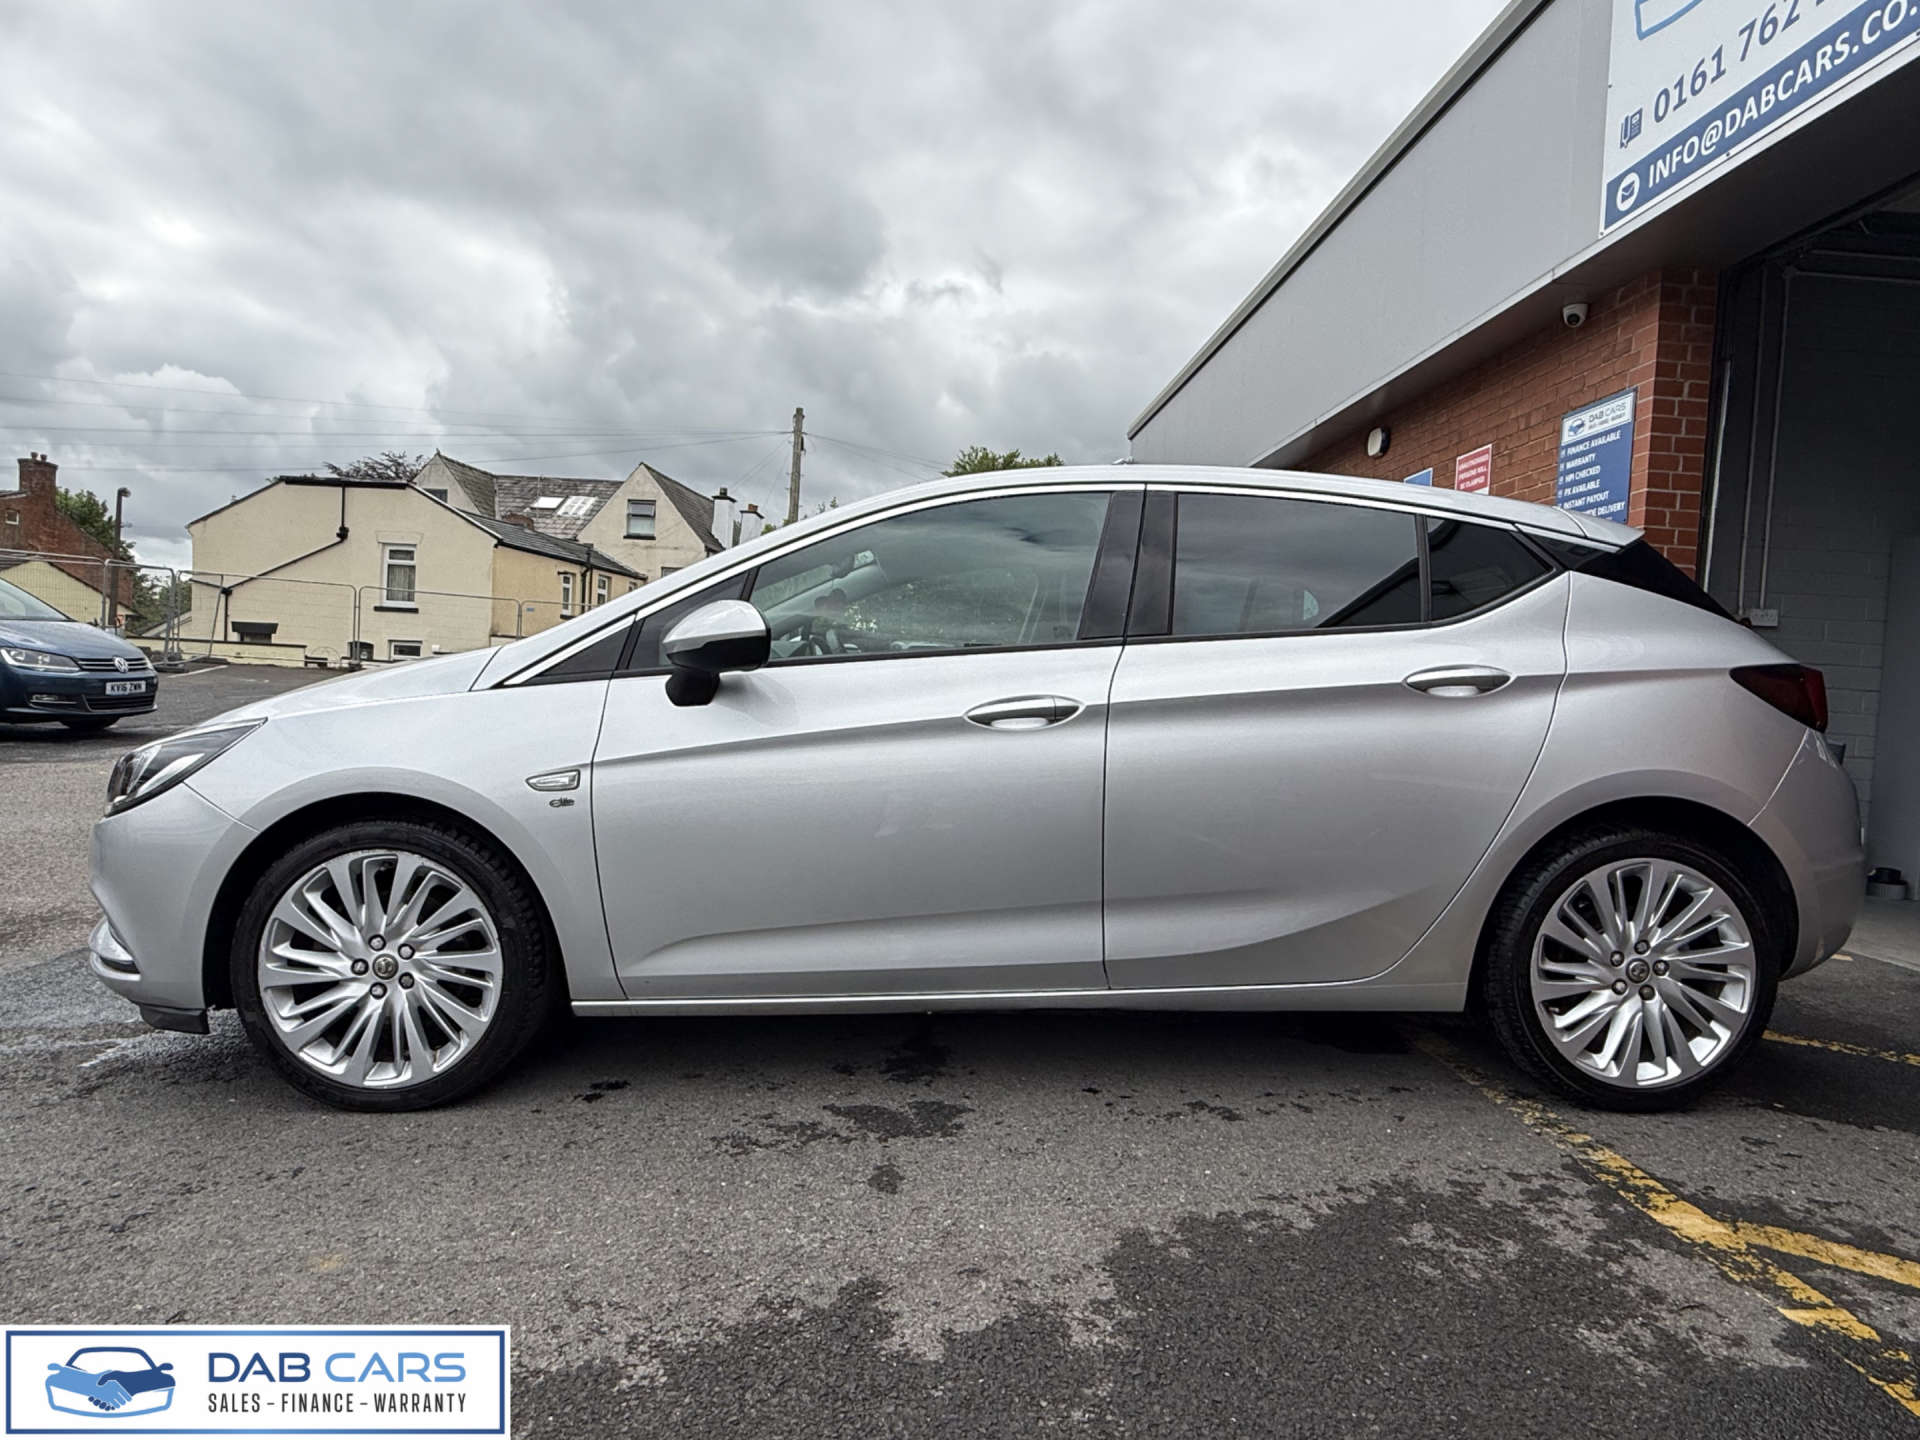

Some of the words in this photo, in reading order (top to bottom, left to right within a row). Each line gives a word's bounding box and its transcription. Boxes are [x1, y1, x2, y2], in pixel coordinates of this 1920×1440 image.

[1654, 44, 1726, 123] 0161
[1738, 0, 1801, 62] 762
[1575, 465, 1601, 480] CHECKED
[1586, 490, 1609, 504] PAYOUT
